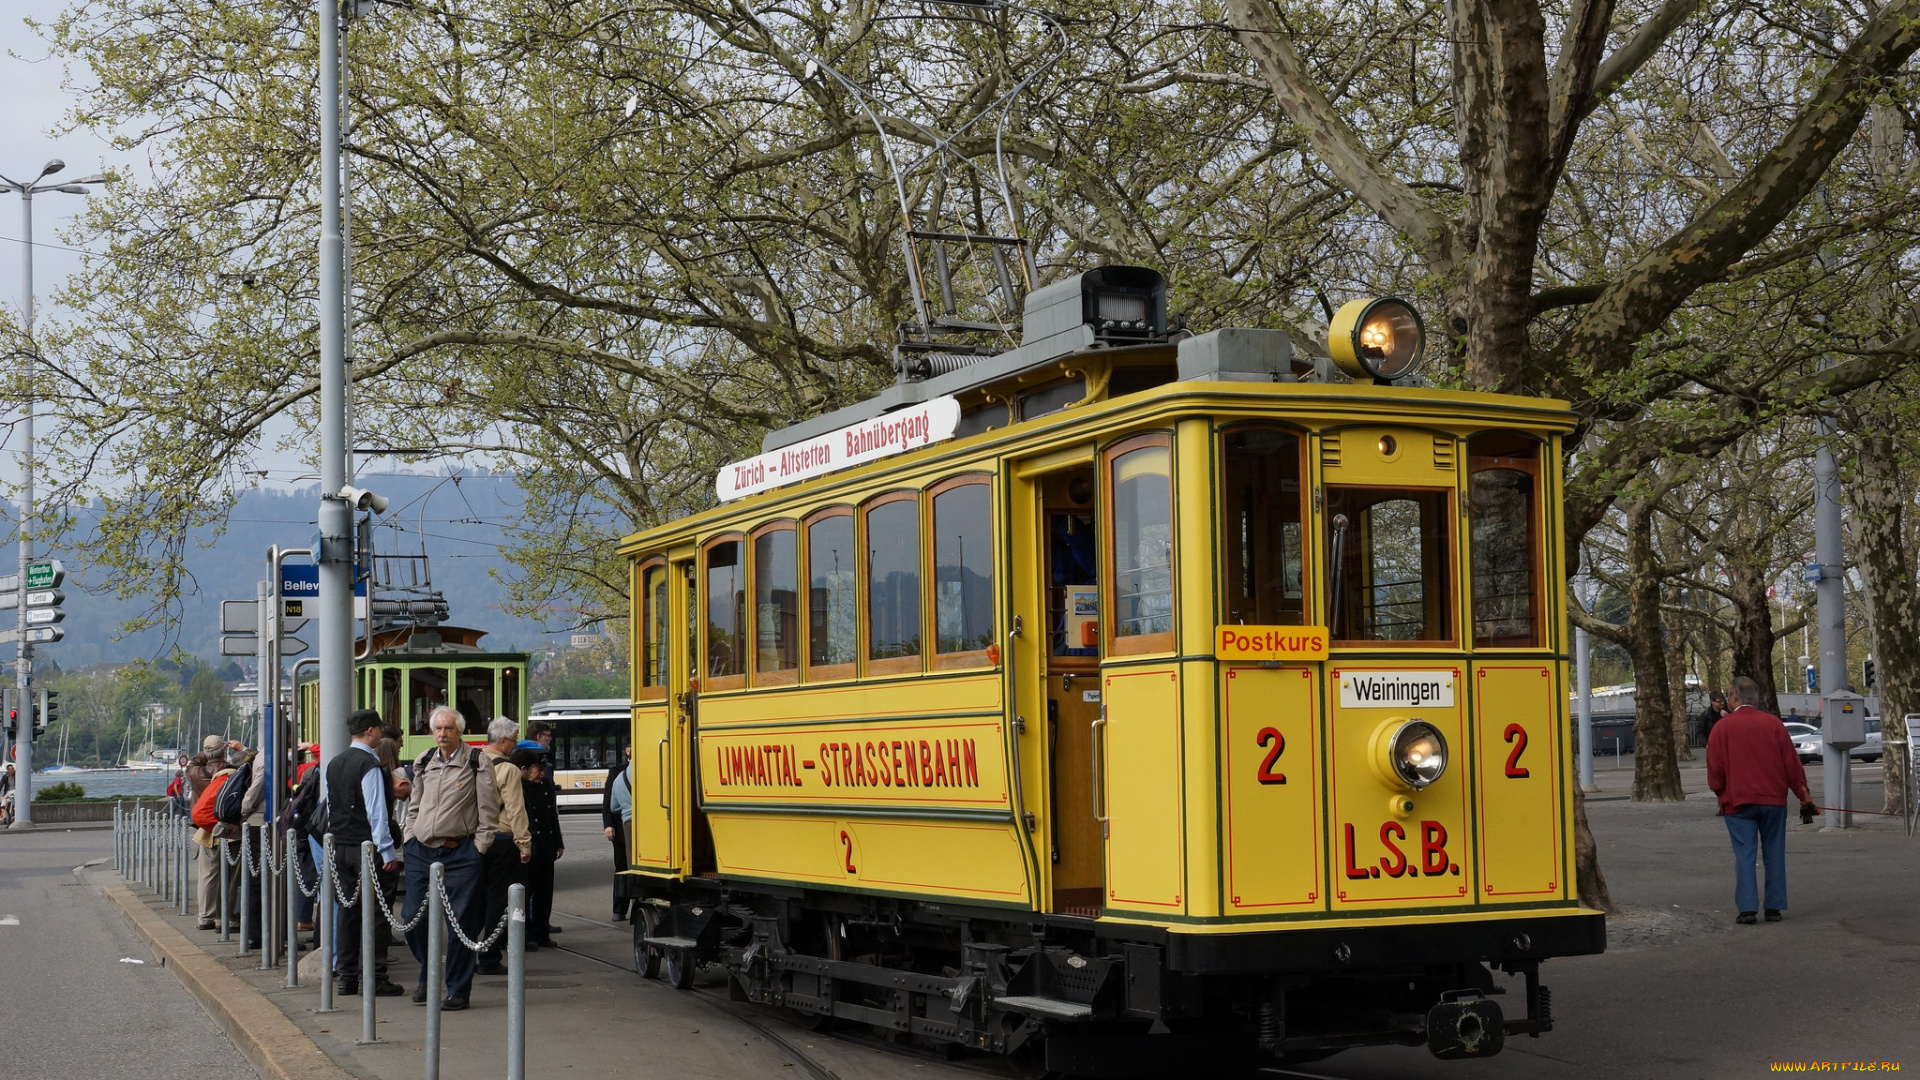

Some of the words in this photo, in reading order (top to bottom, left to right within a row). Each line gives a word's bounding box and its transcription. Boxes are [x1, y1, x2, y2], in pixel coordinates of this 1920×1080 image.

[735, 459, 765, 490] Zürich
[780, 443, 831, 477] Altstetten
[846, 410, 930, 458] Bahnübergang
[1222, 630, 1323, 652] Postkurs
[1353, 676, 1440, 706] Weiningen
[1256, 727, 1287, 785] 2
[1503, 723, 1529, 779] 2
[840, 829, 857, 874] 2
[1344, 820, 1460, 880] L.S.B.
